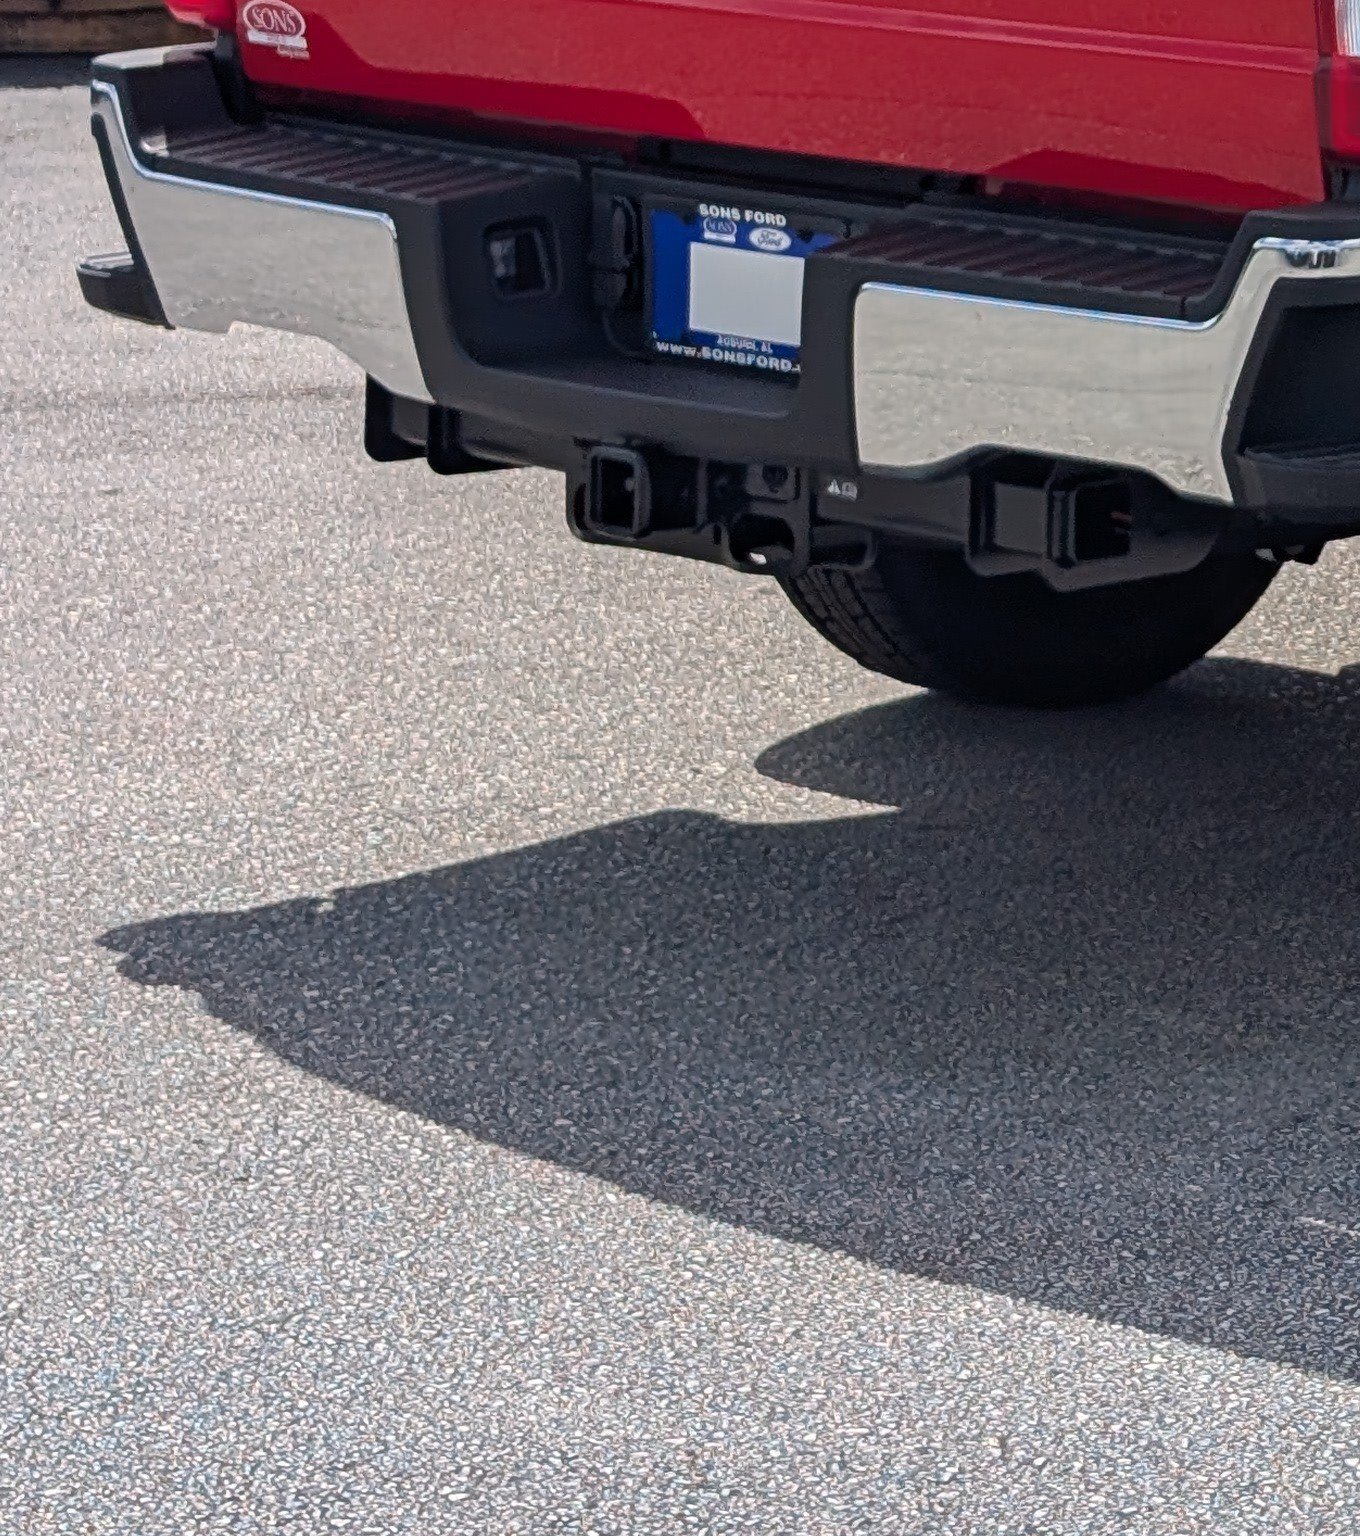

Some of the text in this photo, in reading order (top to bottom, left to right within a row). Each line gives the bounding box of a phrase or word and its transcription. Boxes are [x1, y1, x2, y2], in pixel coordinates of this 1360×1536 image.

[252, 6, 296, 35] SONS
[699, 203, 787, 228] SONS FORD
